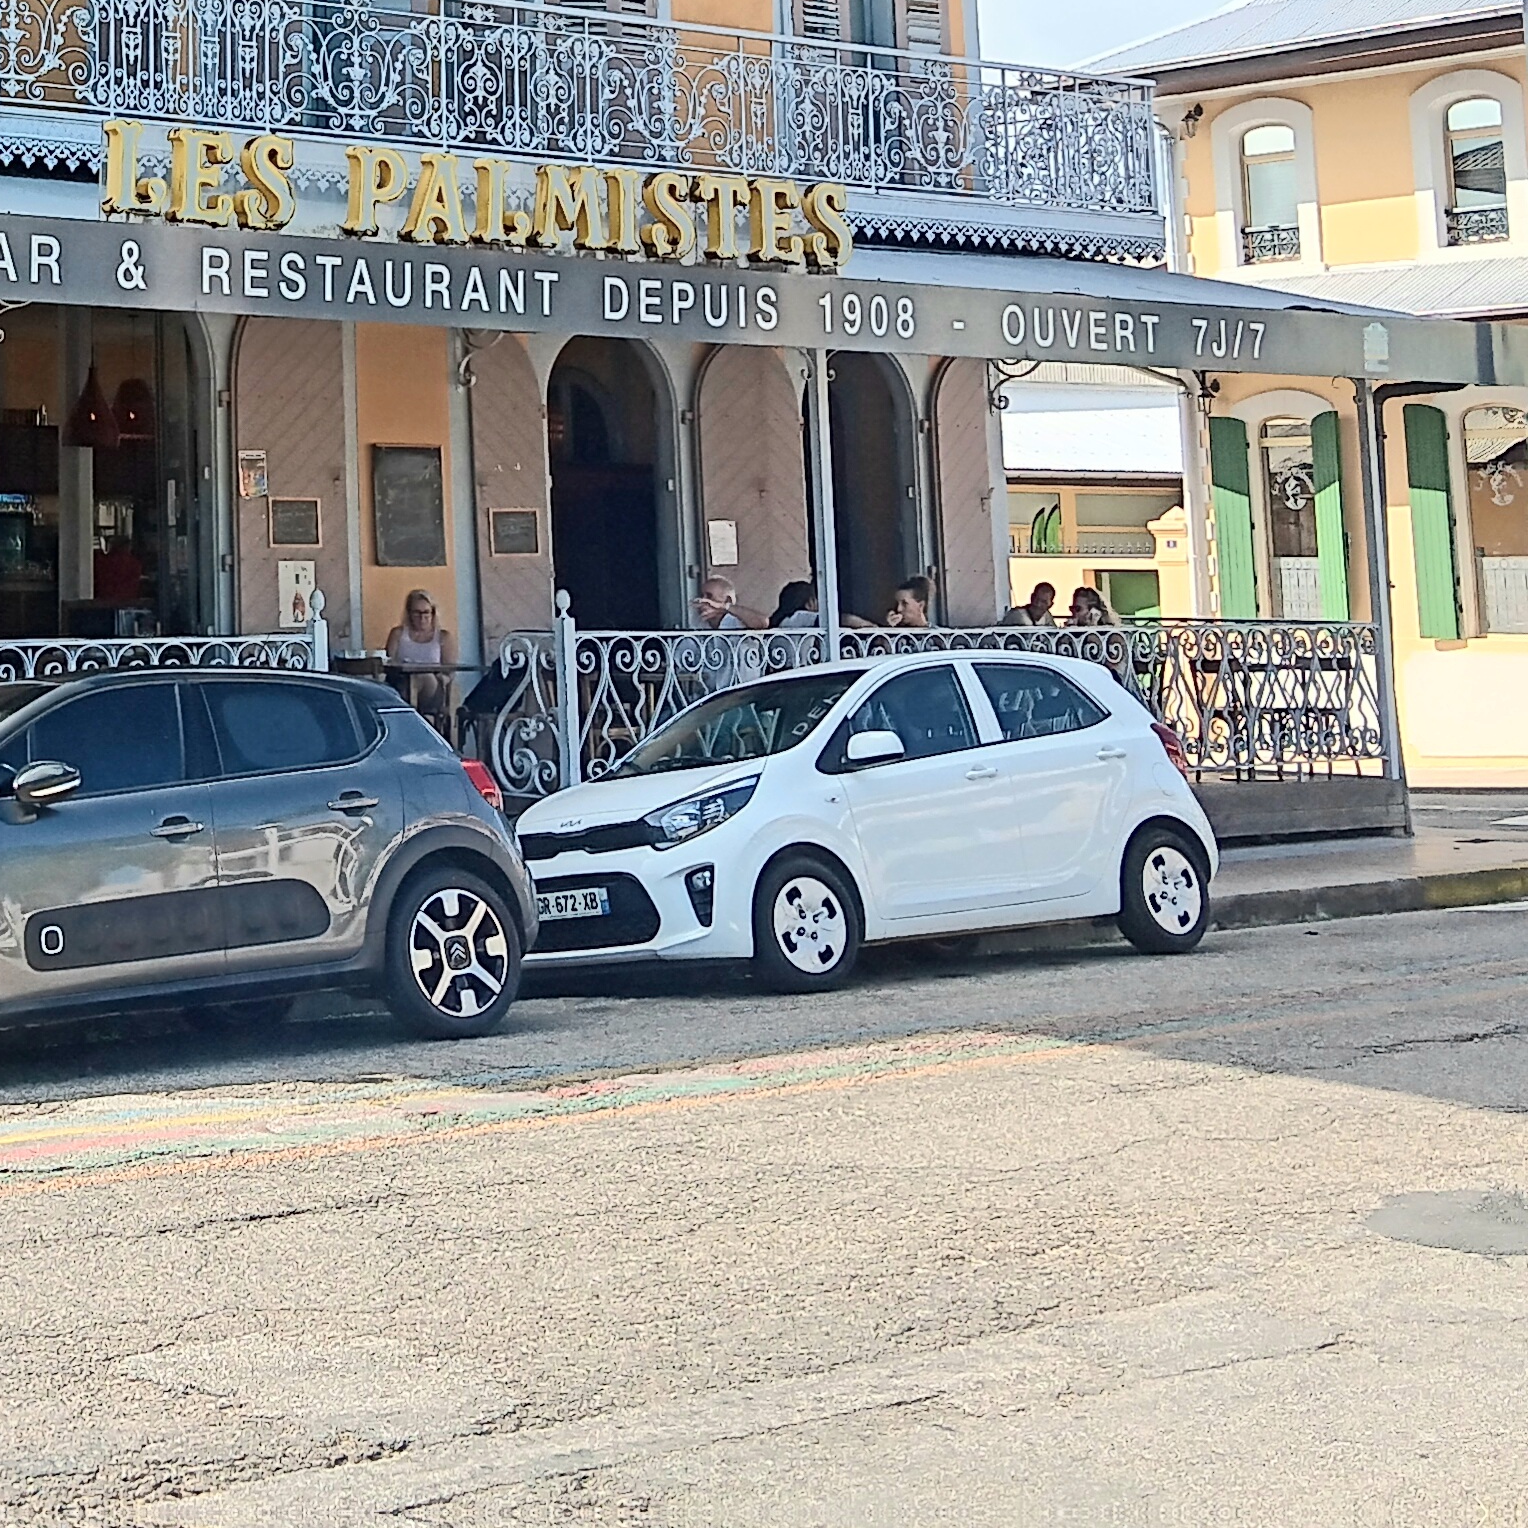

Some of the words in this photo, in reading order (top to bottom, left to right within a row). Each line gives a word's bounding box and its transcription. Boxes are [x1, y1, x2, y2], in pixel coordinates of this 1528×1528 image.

[102, 120, 296, 231] LES
[341, 145, 853, 268] PALMISTES
[116, 239, 147, 291] &
[201, 246, 560, 316] RESTAURANT
[603, 275, 778, 330] DEPUIS
[818, 292, 915, 338] 1908
[1001, 303, 1160, 353] OUVERT
[1191, 318, 1266, 359] 7J/7
